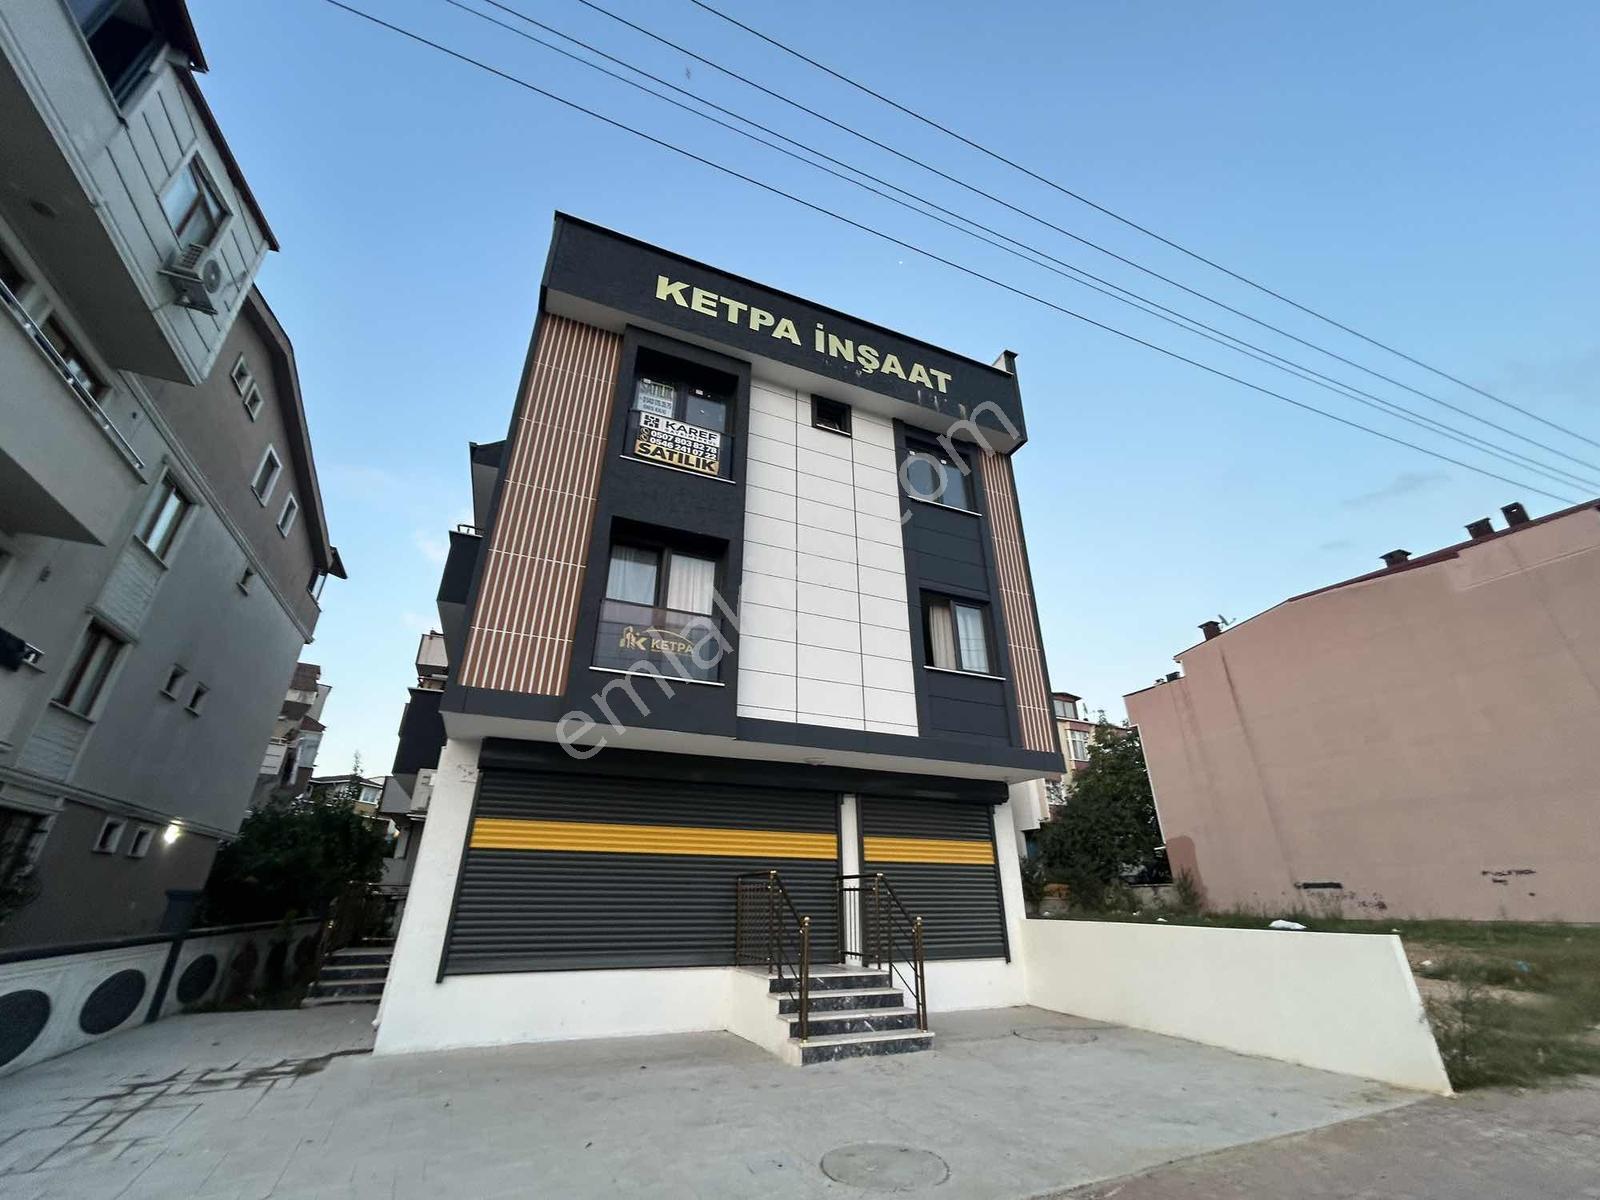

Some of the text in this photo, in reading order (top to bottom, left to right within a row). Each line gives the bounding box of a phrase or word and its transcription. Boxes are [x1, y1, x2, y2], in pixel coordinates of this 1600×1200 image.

[655, 275, 951, 394] KETPA İNŞAAT
[651, 430, 717, 454] 0507 803 82 78
[666, 421, 717, 440] KAREF
[637, 442, 716, 472] SATILIK
[650, 437, 717, 460] 0546 241 07 22
[651, 639, 693, 653] KETPA
